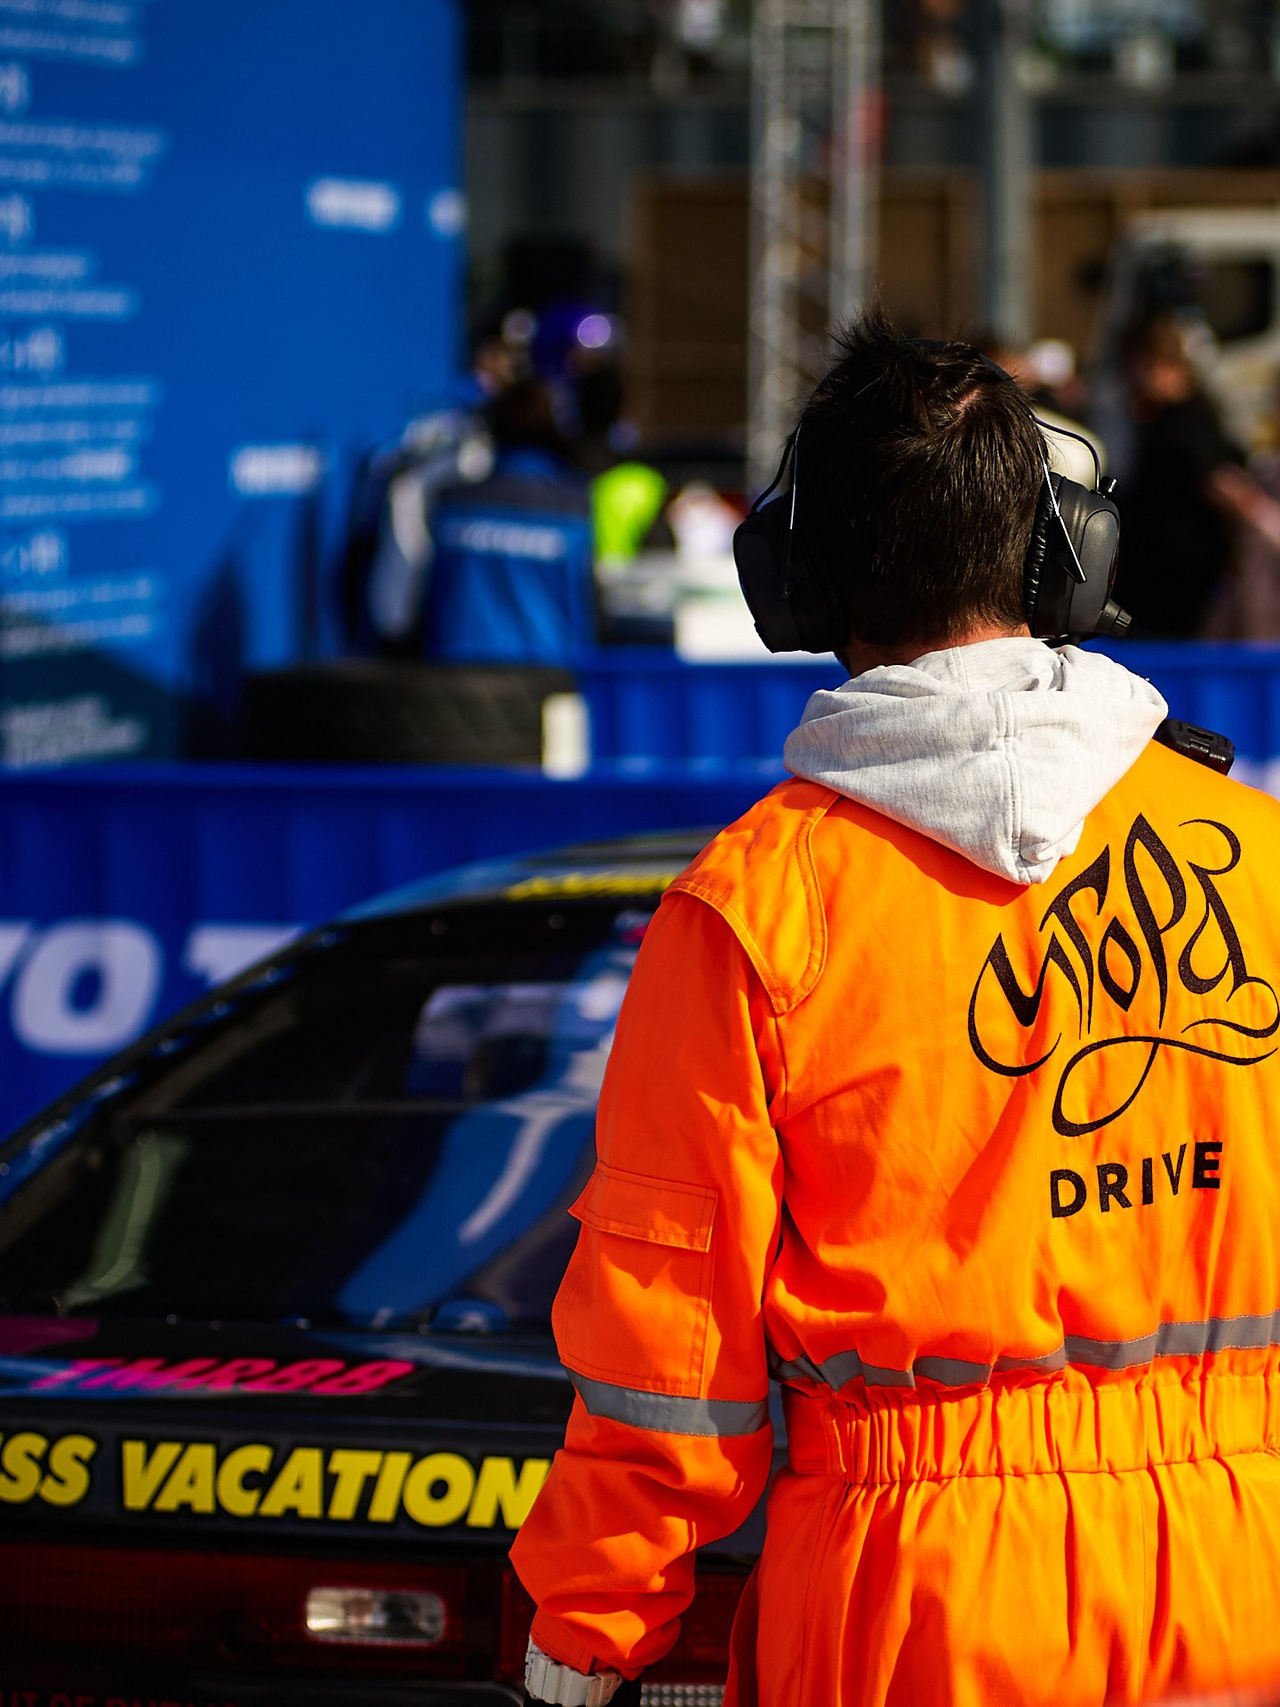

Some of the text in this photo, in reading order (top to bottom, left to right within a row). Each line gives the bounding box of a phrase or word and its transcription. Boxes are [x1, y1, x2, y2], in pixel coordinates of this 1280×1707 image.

[1049, 1140, 1224, 1219] DRIVE
[0, 1431, 552, 1531] SS VACATION
